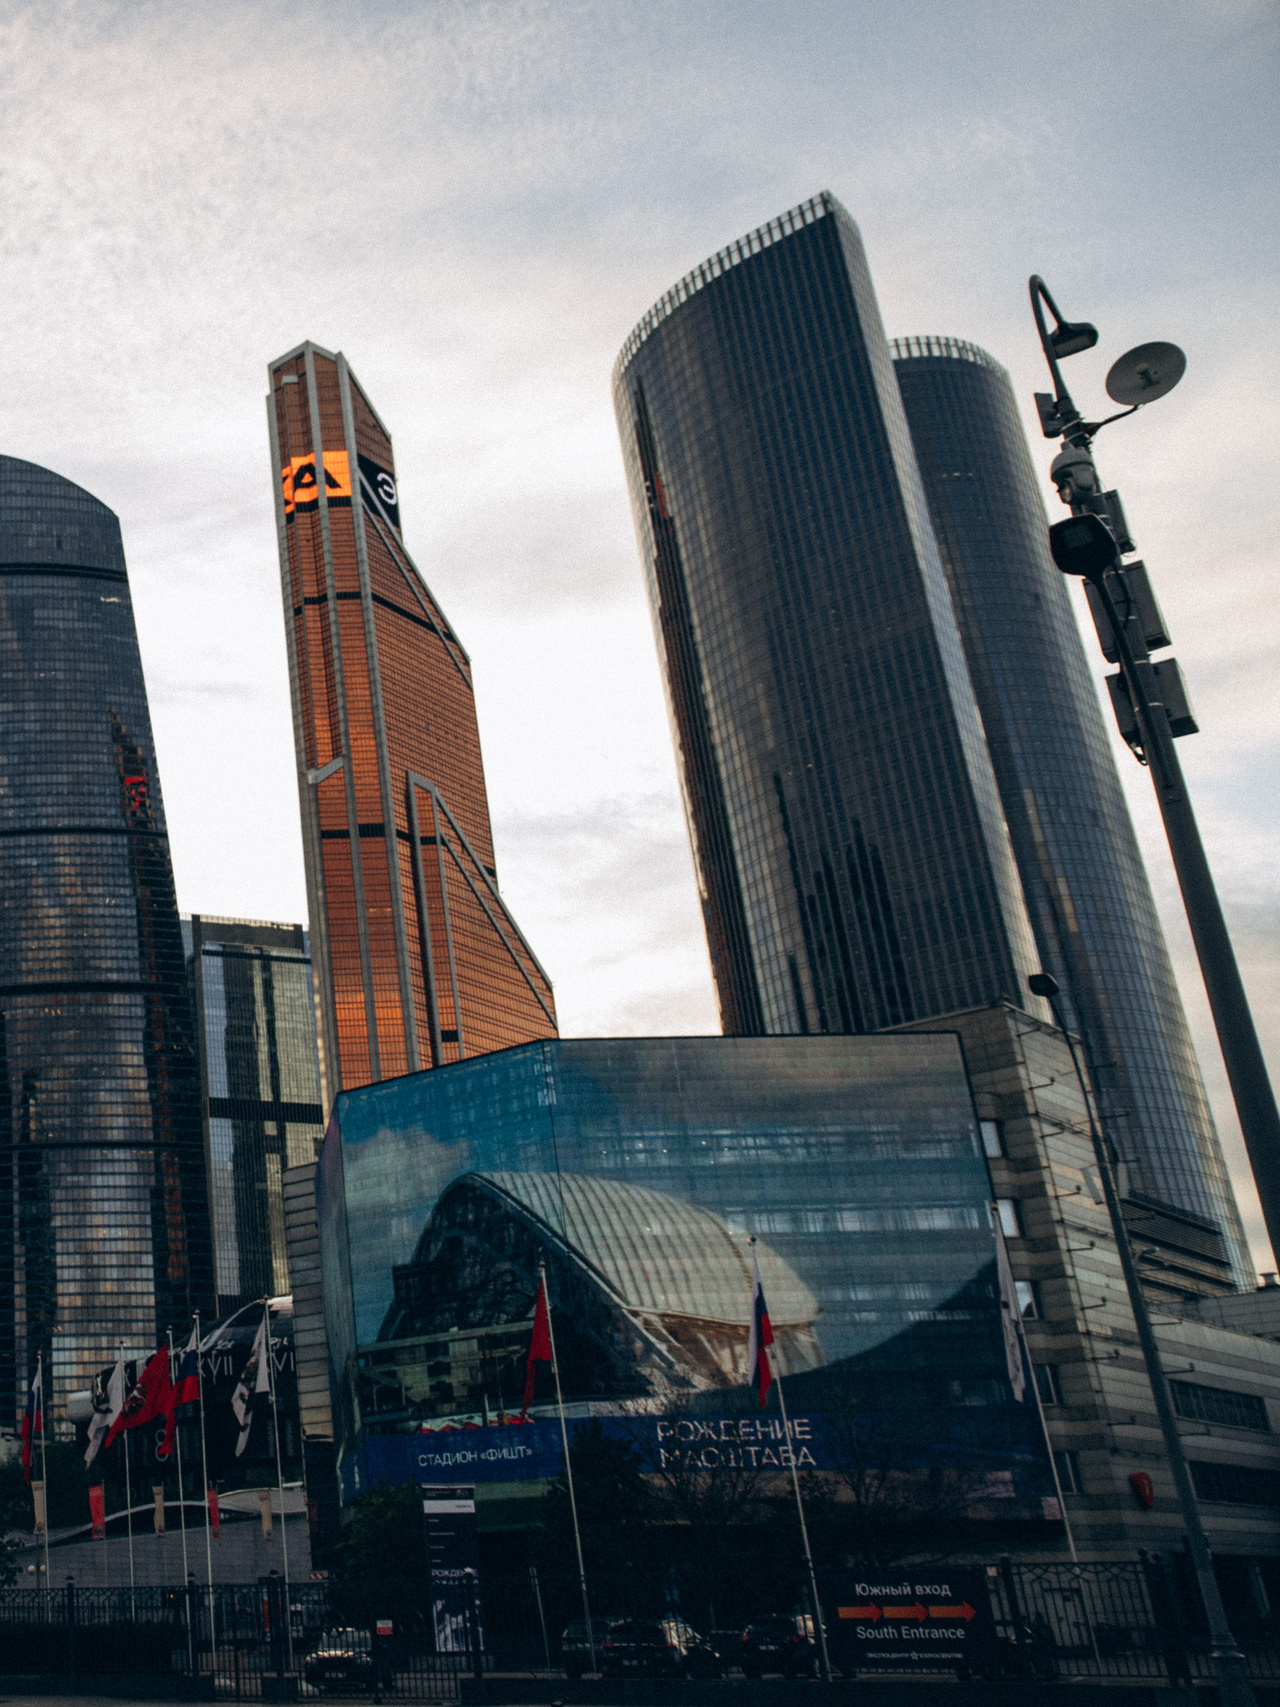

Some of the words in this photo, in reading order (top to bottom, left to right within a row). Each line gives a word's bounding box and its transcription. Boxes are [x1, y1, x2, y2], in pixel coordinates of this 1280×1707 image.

[657, 1419, 812, 1441] РОЖДЕНИЕ
[418, 1450, 478, 1467] СТАДИОН
[480, 1445, 533, 1461] «ФИШТ»
[855, 1582, 912, 1596] Южный
[915, 1584, 952, 1597] вход
[856, 1625, 898, 1639] South
[901, 1625, 966, 1639] Entrance
